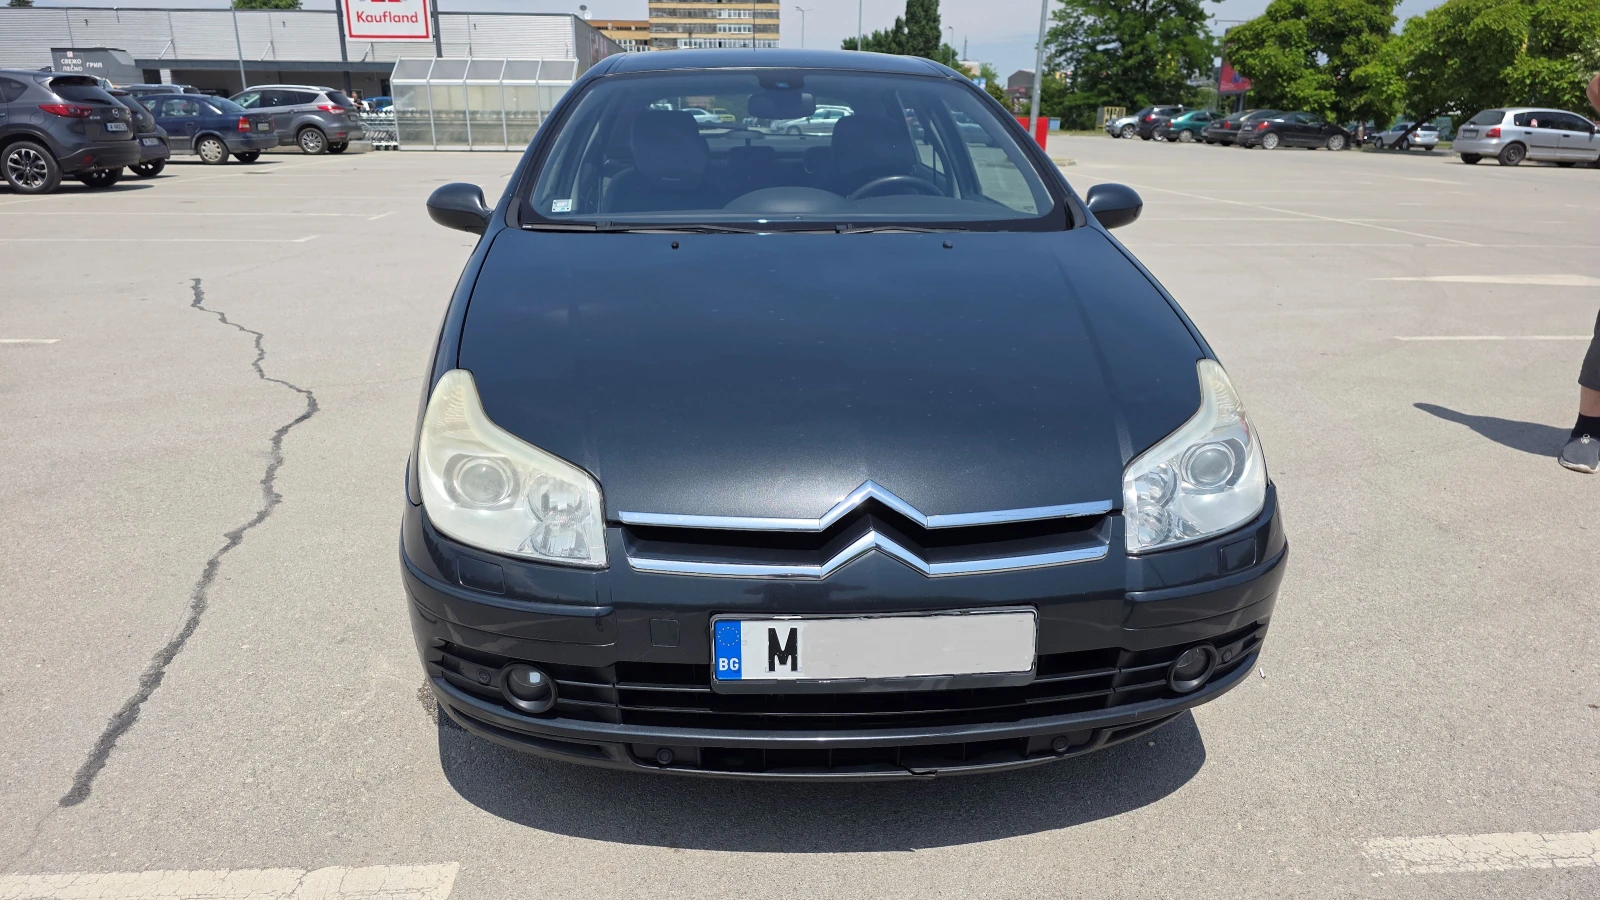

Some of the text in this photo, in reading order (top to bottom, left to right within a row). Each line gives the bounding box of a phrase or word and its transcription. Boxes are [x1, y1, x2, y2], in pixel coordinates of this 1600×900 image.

[356, 10, 419, 23] Kaufland
[768, 628, 798, 672] M
[718, 657, 740, 670] BG
